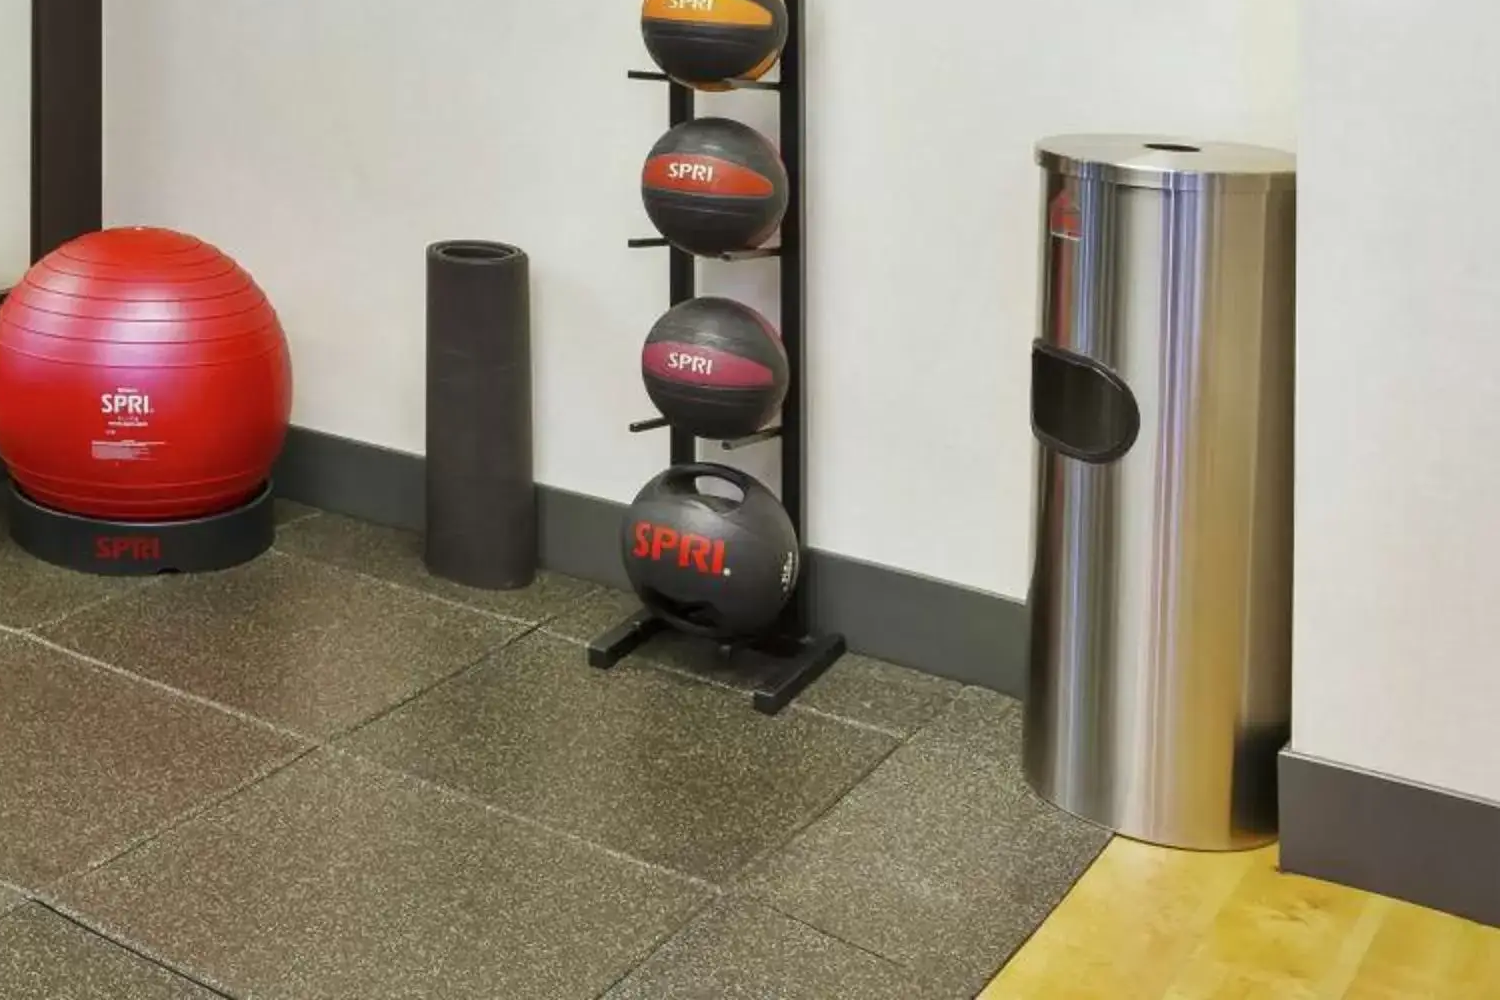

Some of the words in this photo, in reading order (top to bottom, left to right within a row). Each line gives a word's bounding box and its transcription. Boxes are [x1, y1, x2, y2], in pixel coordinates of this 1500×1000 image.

[668, 162, 714, 182] SPRI
[668, 352, 713, 375] SPRI
[101, 393, 150, 414] SPRI
[94, 536, 161, 560] SPRI
[632, 520, 726, 575] SPRI
